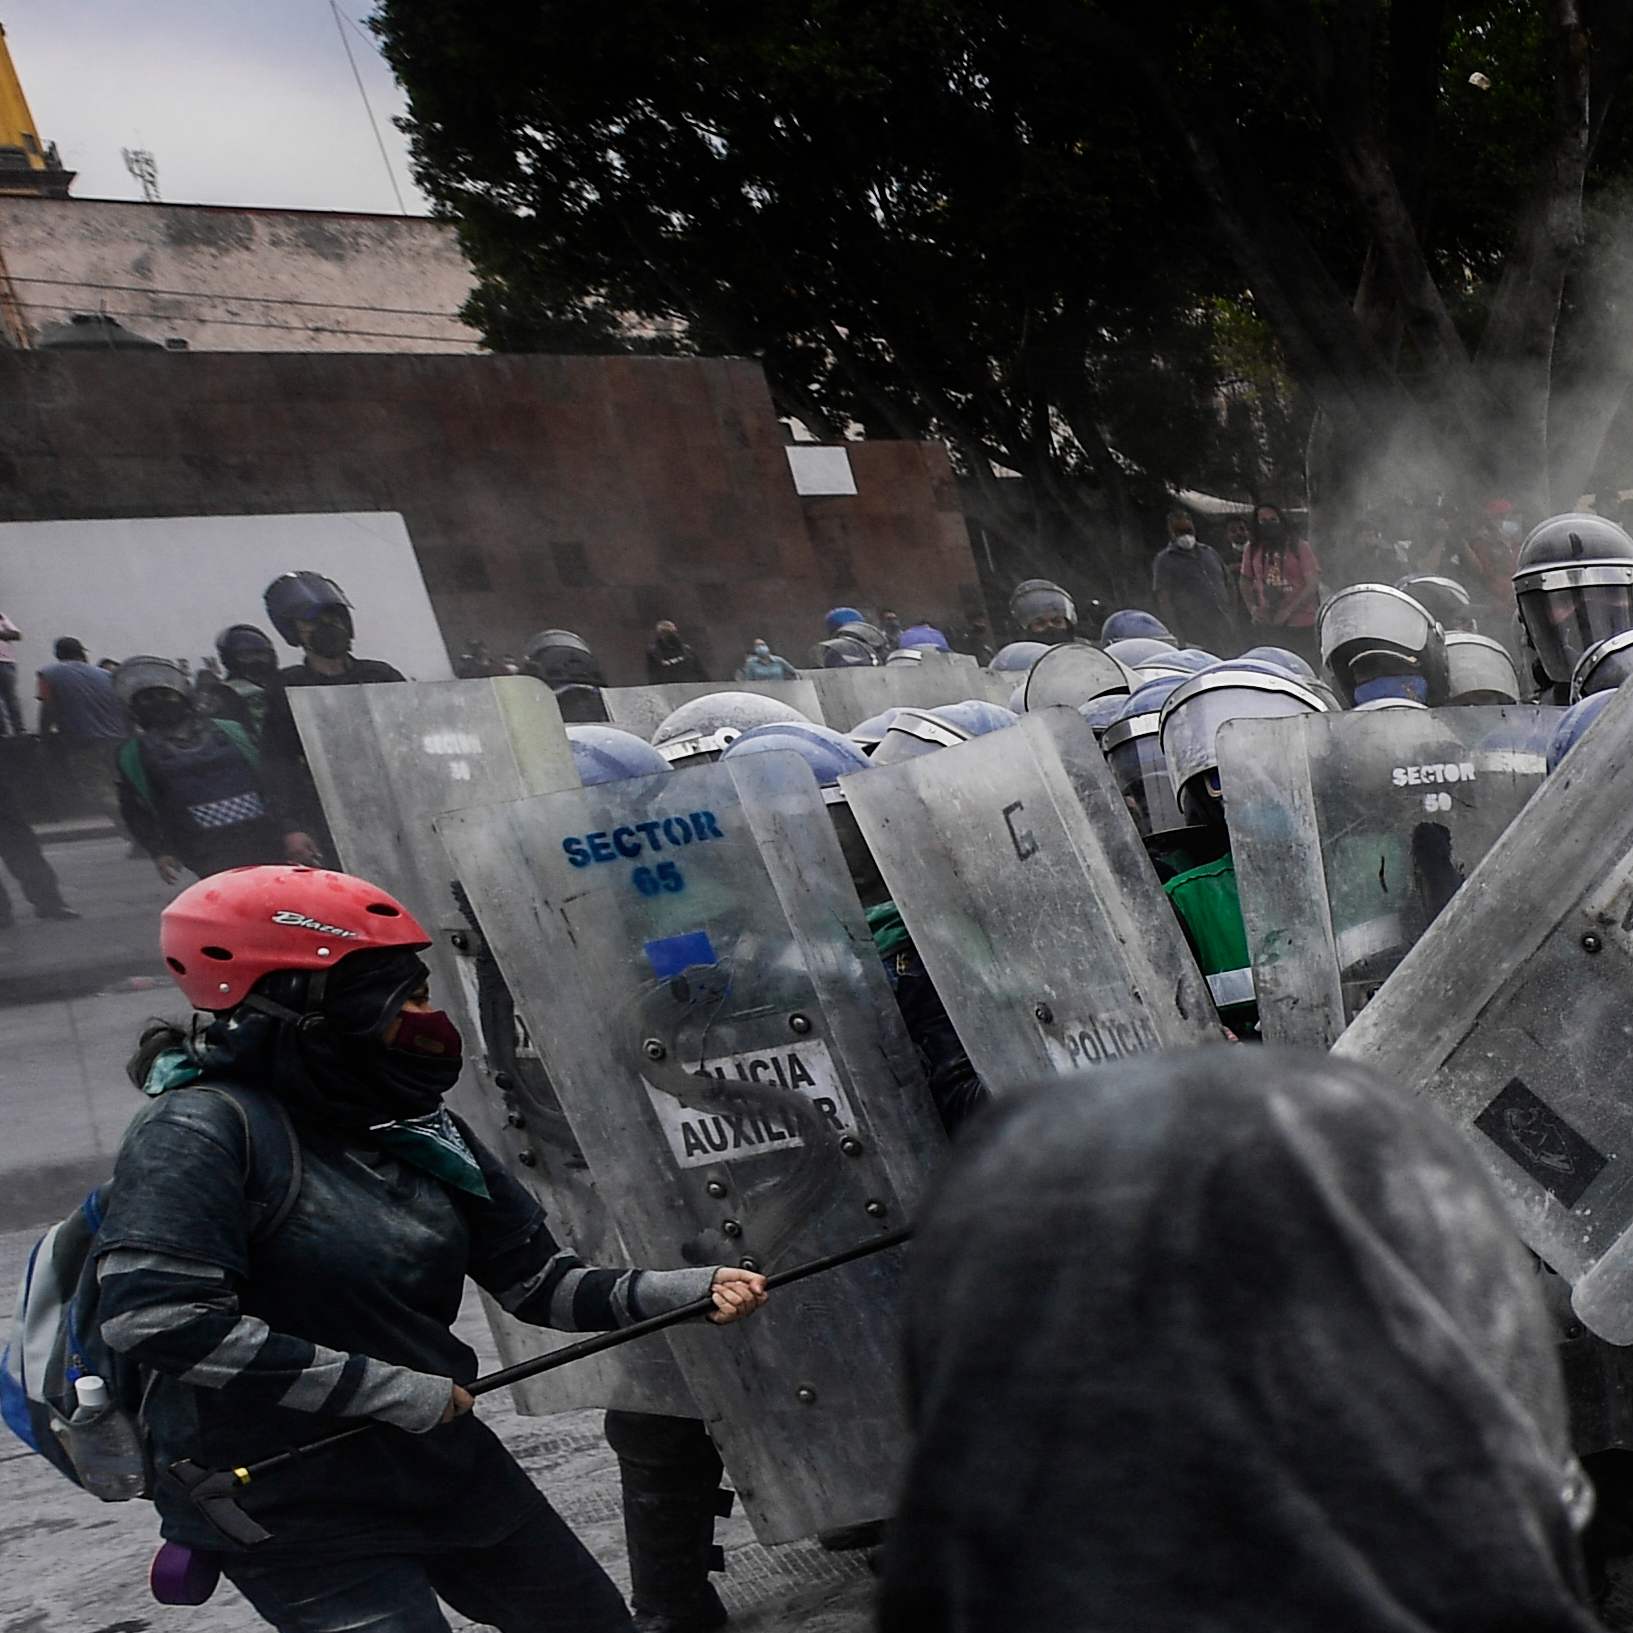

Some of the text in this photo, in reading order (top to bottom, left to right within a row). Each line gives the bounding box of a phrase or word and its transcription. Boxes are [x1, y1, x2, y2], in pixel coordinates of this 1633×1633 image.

[1392, 762, 1477, 787] SECTOR
[1424, 791, 1452, 812] 50
[562, 808, 724, 868] SECTOR
[271, 910, 359, 938] Blazer
[679, 1053, 816, 1108] ICIA
[681, 1096, 849, 1158] AUXILR
